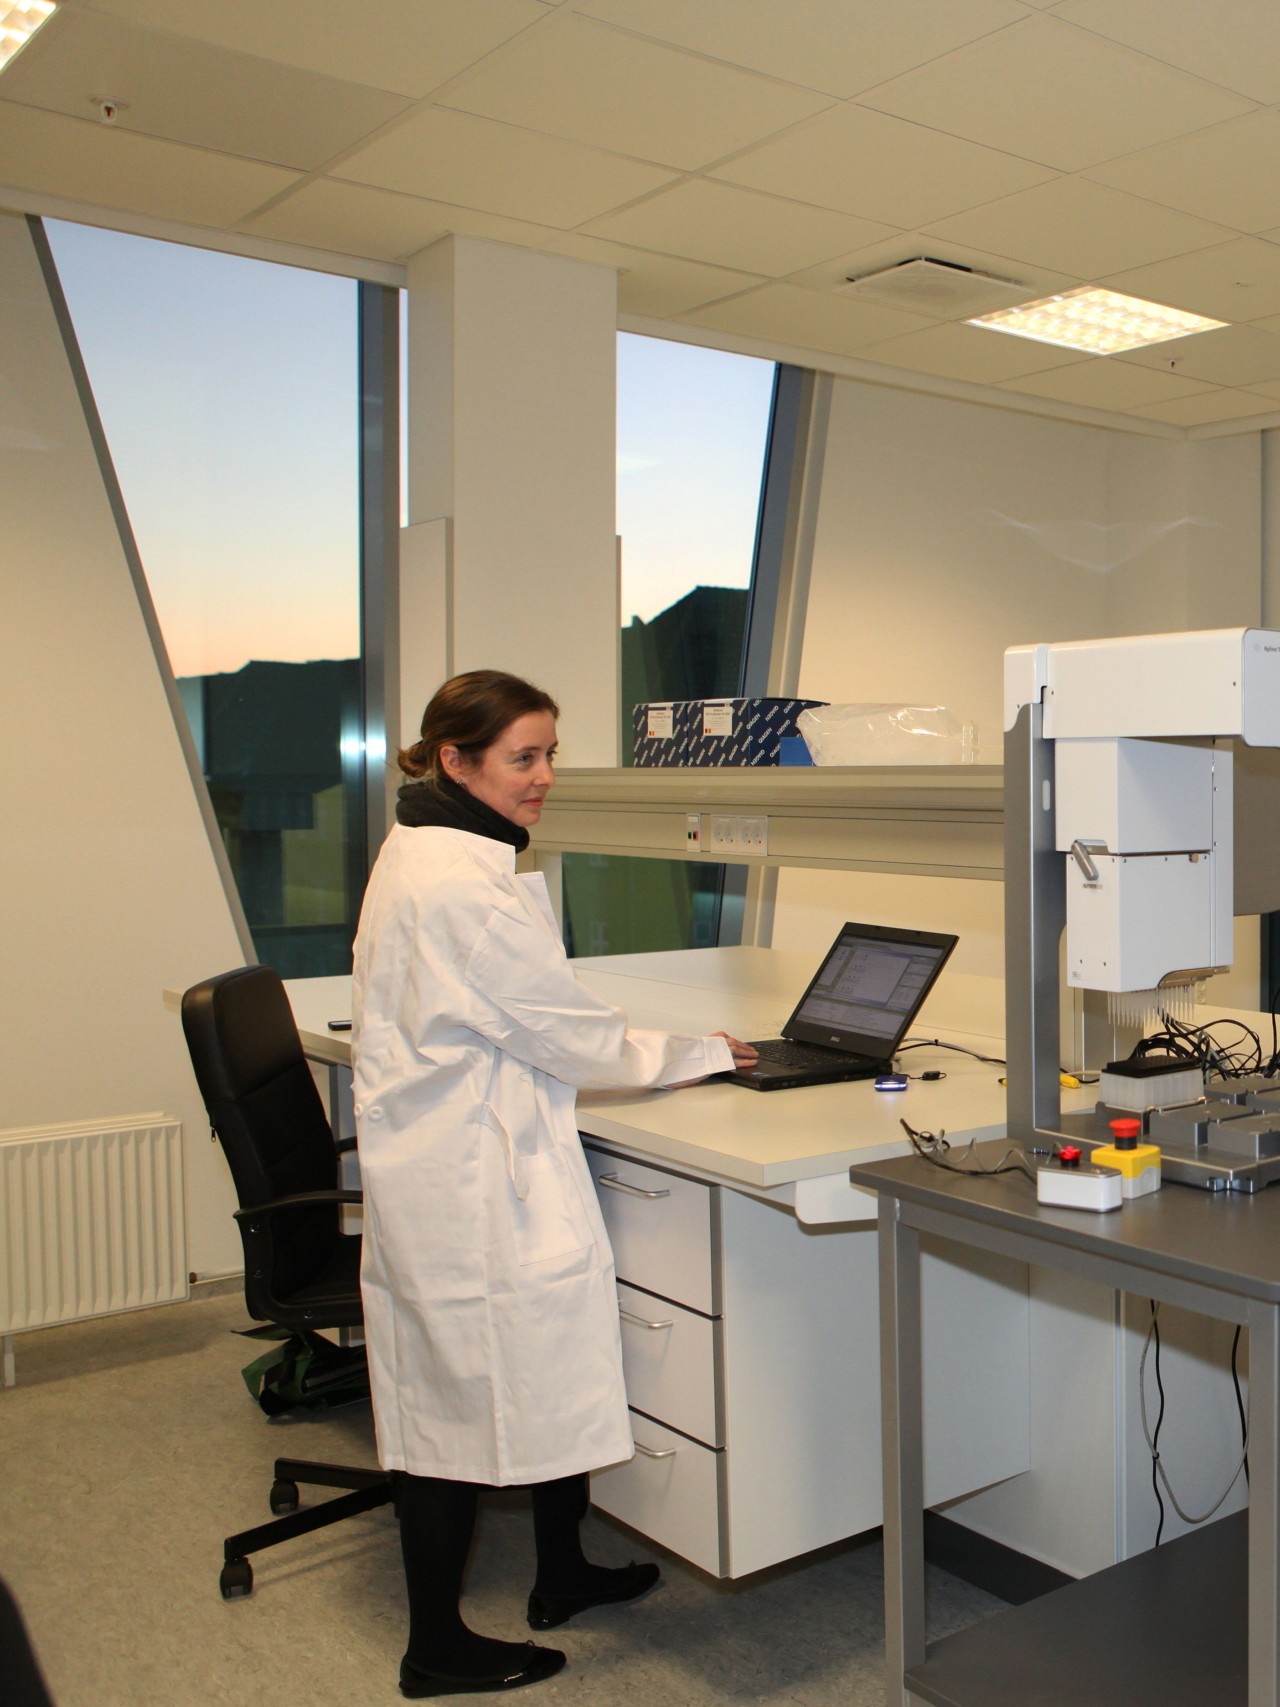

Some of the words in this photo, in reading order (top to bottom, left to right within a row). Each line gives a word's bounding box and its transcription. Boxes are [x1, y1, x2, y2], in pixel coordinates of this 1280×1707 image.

[746, 713, 761, 730] QIAGEN
[765, 705, 779, 722] QIAGEN
[758, 727, 773, 744] QIAGEN
[776, 719, 791, 736] QIAGEN
[750, 749, 766, 766] QIAGEN
